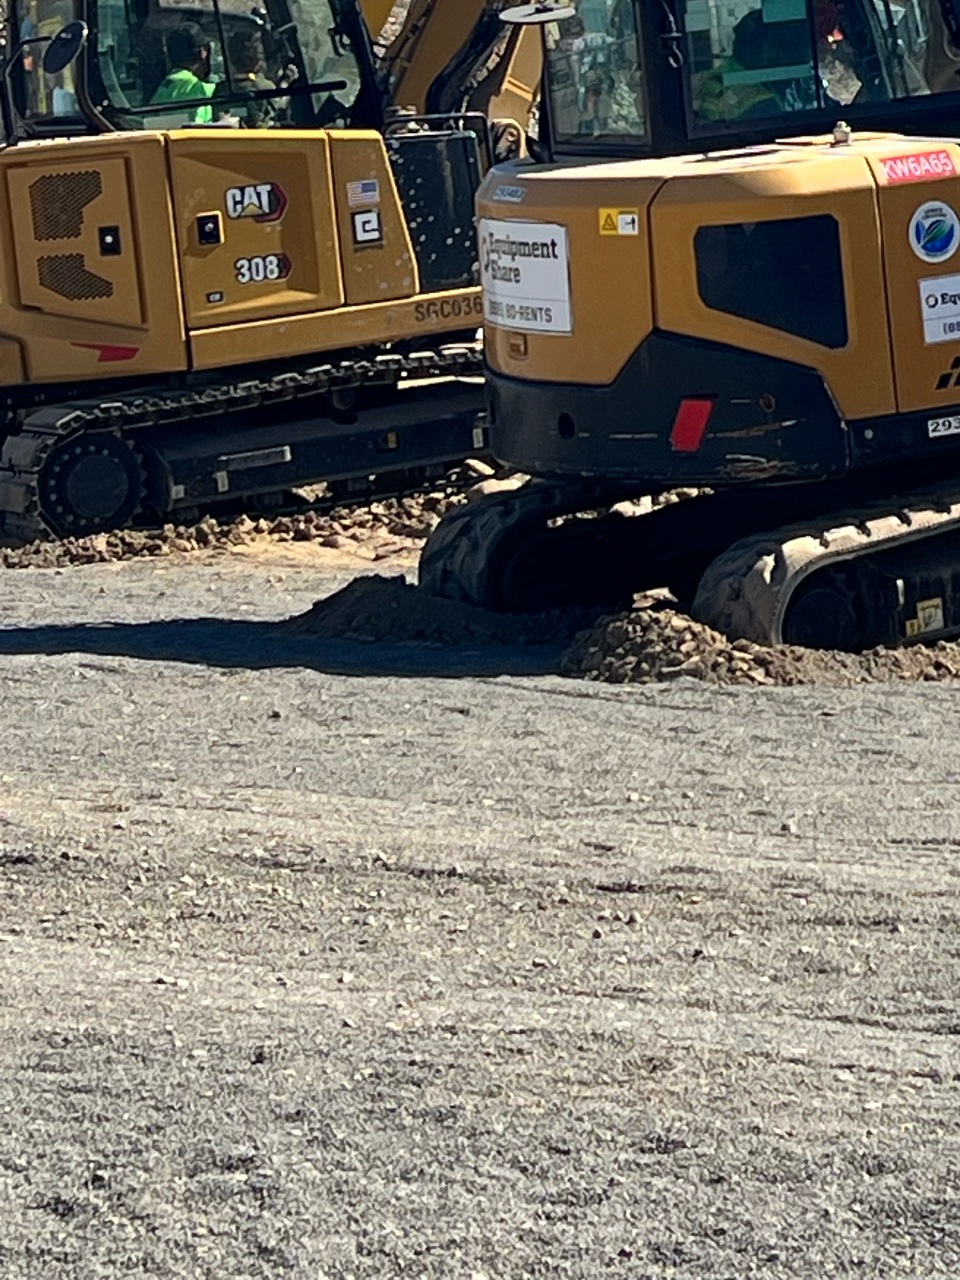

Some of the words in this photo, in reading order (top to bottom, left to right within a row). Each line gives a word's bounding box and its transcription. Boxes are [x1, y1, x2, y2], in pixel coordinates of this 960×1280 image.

[882, 152, 954, 180] KW6A65
[226, 184, 272, 219] CAT
[489, 232, 559, 262] Equipment
[236, 255, 280, 284] 308
[491, 260, 521, 283] Share
[414, 296, 483, 322] SGC036
